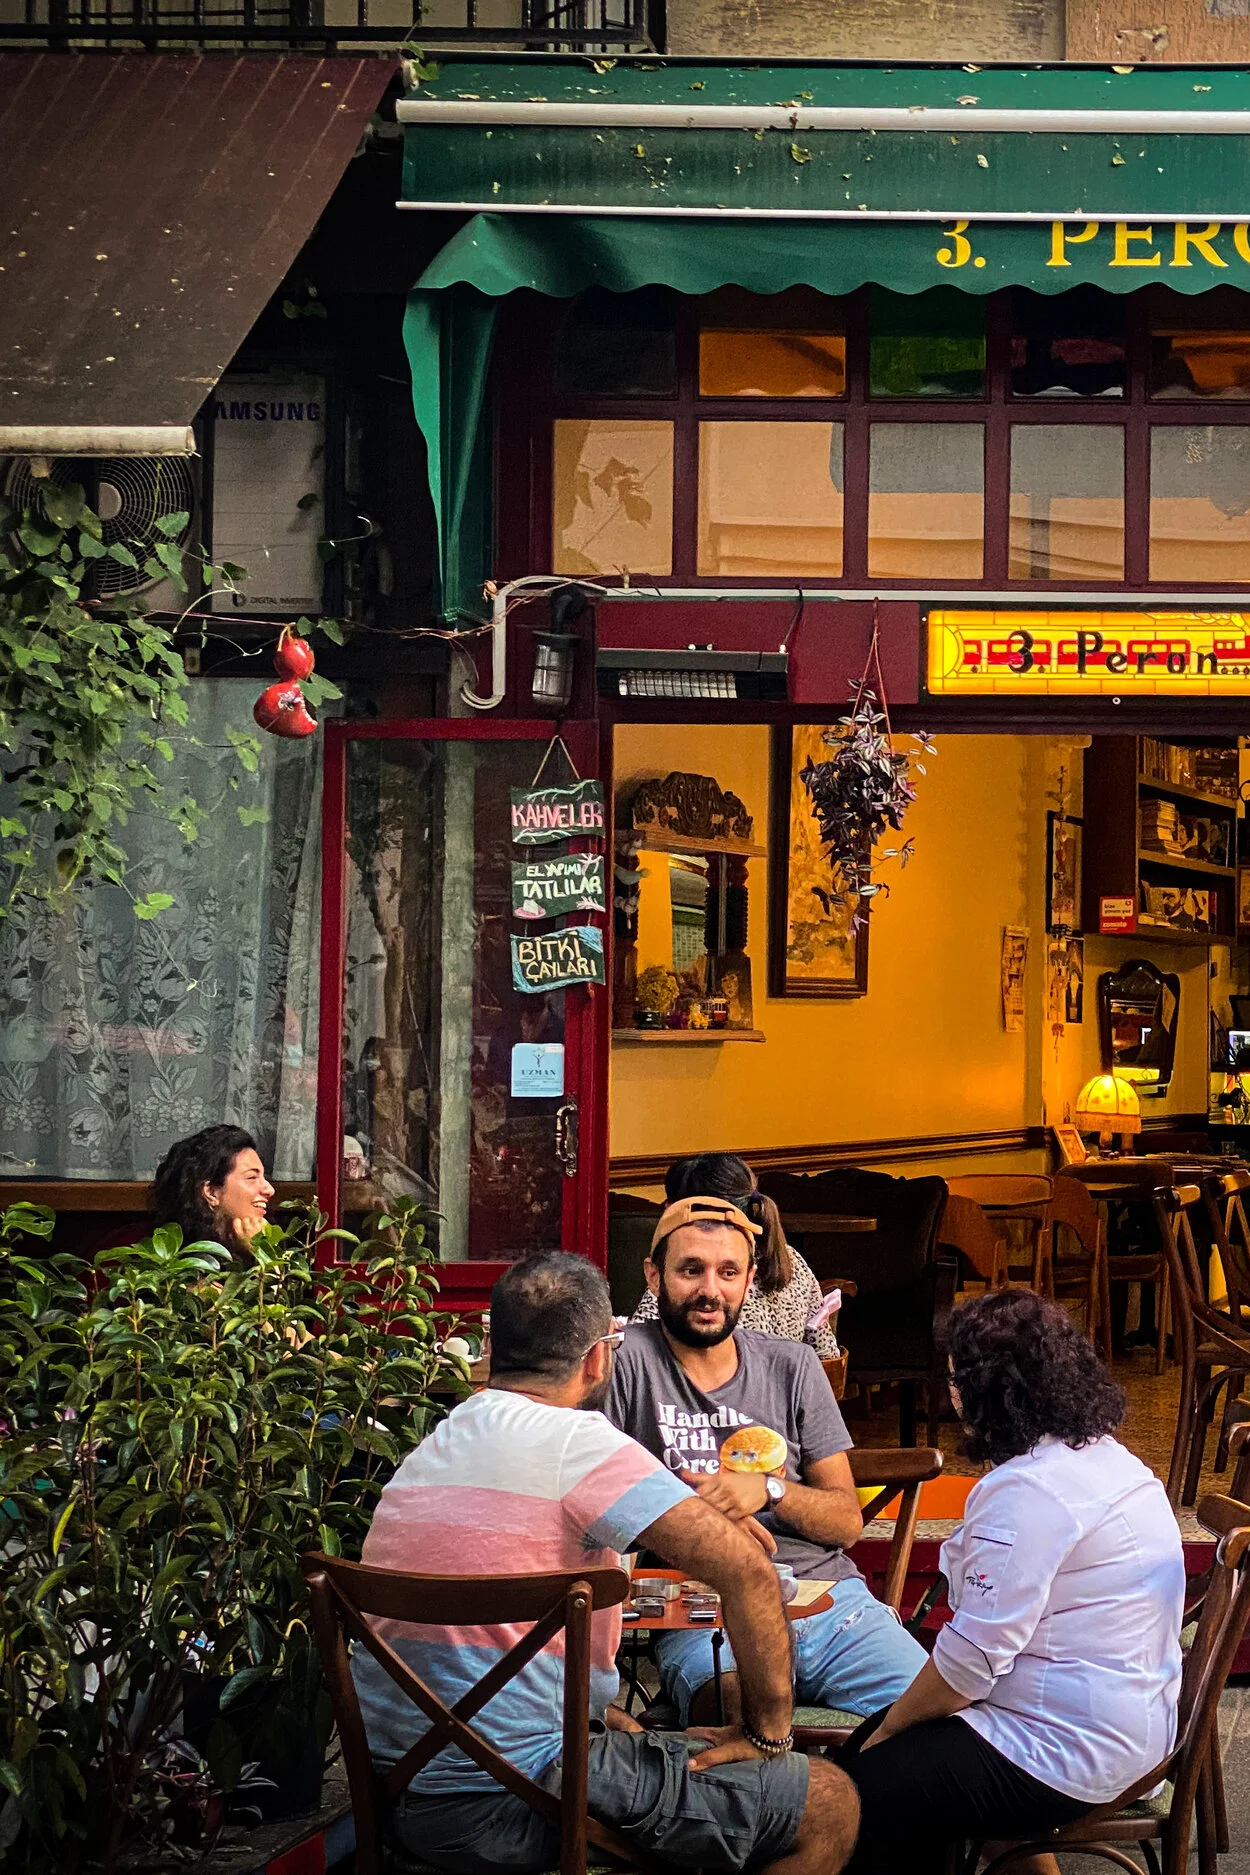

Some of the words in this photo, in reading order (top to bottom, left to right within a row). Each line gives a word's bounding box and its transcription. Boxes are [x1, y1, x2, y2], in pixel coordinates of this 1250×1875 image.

[511, 802, 603, 828] KAHVELER
[526, 865, 546, 878] EL
[514, 875, 603, 900] TATLILAR
